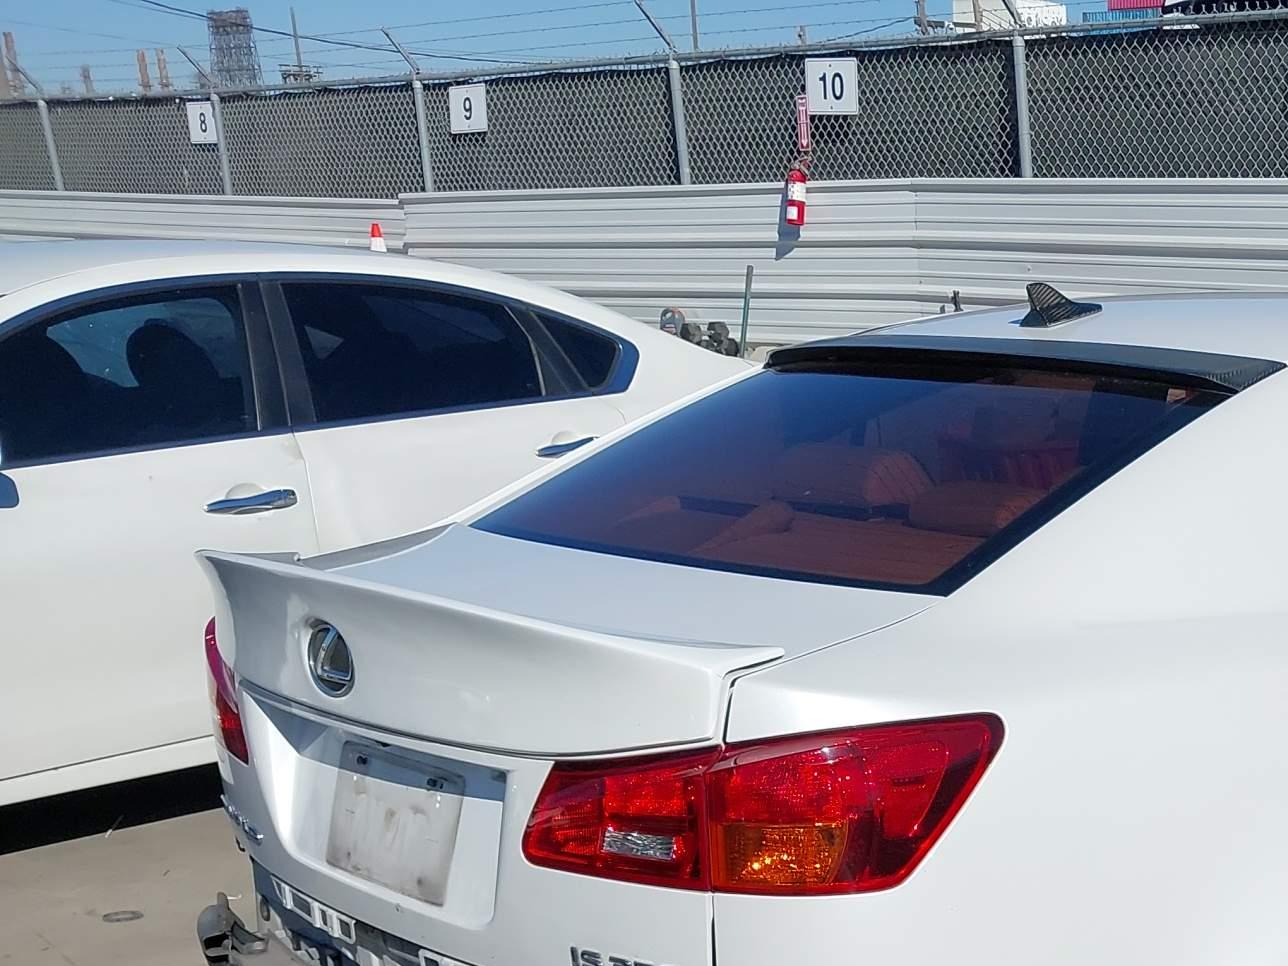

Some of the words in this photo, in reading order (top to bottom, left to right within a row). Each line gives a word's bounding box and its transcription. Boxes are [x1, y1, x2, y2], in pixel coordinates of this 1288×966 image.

[819, 72, 844, 100] 10
[463, 97, 472, 120] 9
[199, 112, 207, 133] 8
